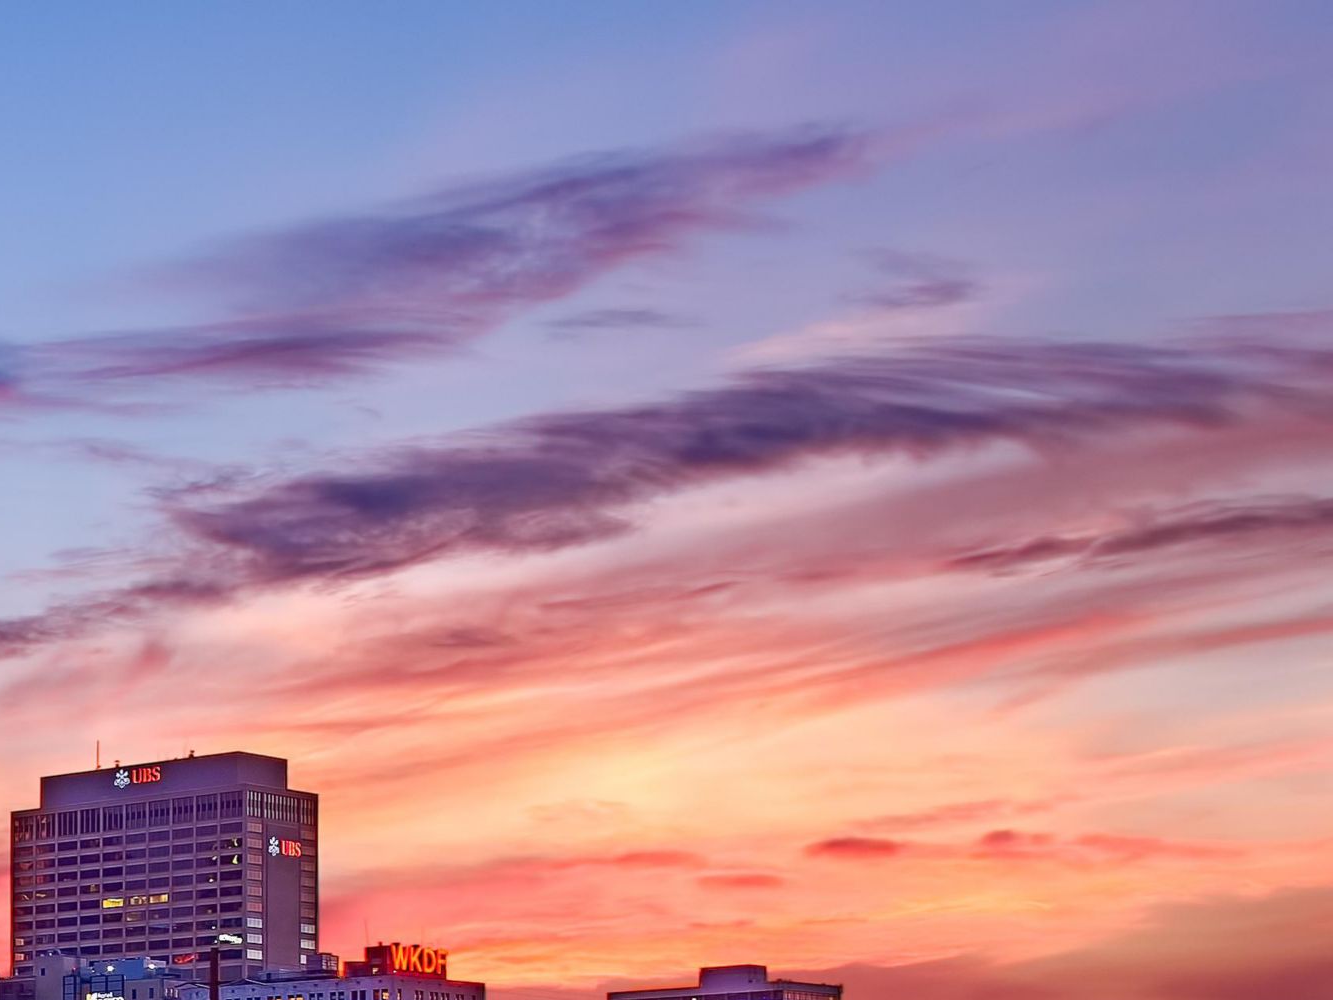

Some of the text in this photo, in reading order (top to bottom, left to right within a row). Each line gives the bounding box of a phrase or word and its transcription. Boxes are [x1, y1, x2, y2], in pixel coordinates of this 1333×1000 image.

[131, 766, 161, 784] UBS
[280, 840, 302, 857] UBS
[391, 943, 447, 974] WKDF
